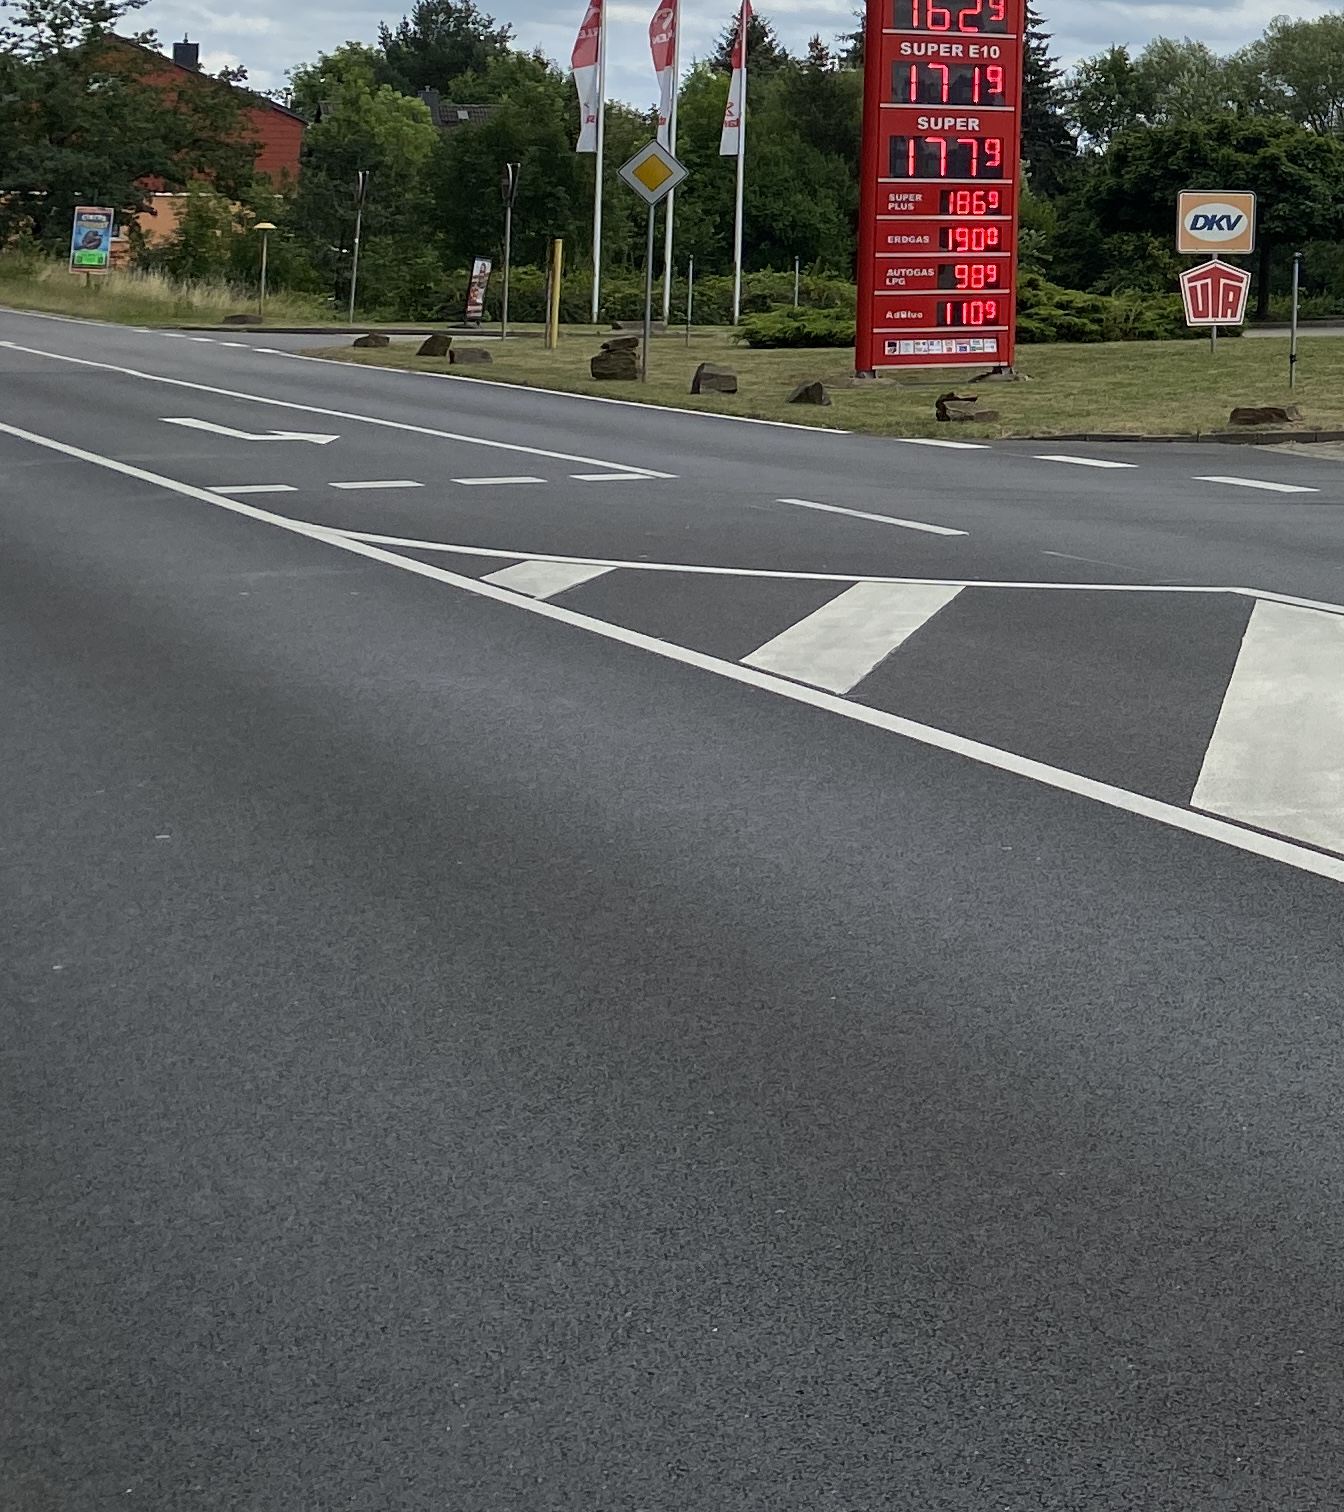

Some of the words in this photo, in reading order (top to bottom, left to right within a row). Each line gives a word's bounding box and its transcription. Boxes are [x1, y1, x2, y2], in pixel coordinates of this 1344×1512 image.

[900, 41, 964, 57] SUPER
[968, 44, 1000, 59] E10
[917, 116, 980, 131] SUPER
[888, 193, 923, 202] SUPER
[887, 202, 915, 211] PLUS
[1190, 214, 1243, 231] DKV
[887, 235, 930, 244] ERDGAS
[886, 268, 935, 277] AUTOGAS
[885, 277, 906, 286] LPG
[1187, 266, 1244, 319] UTA
